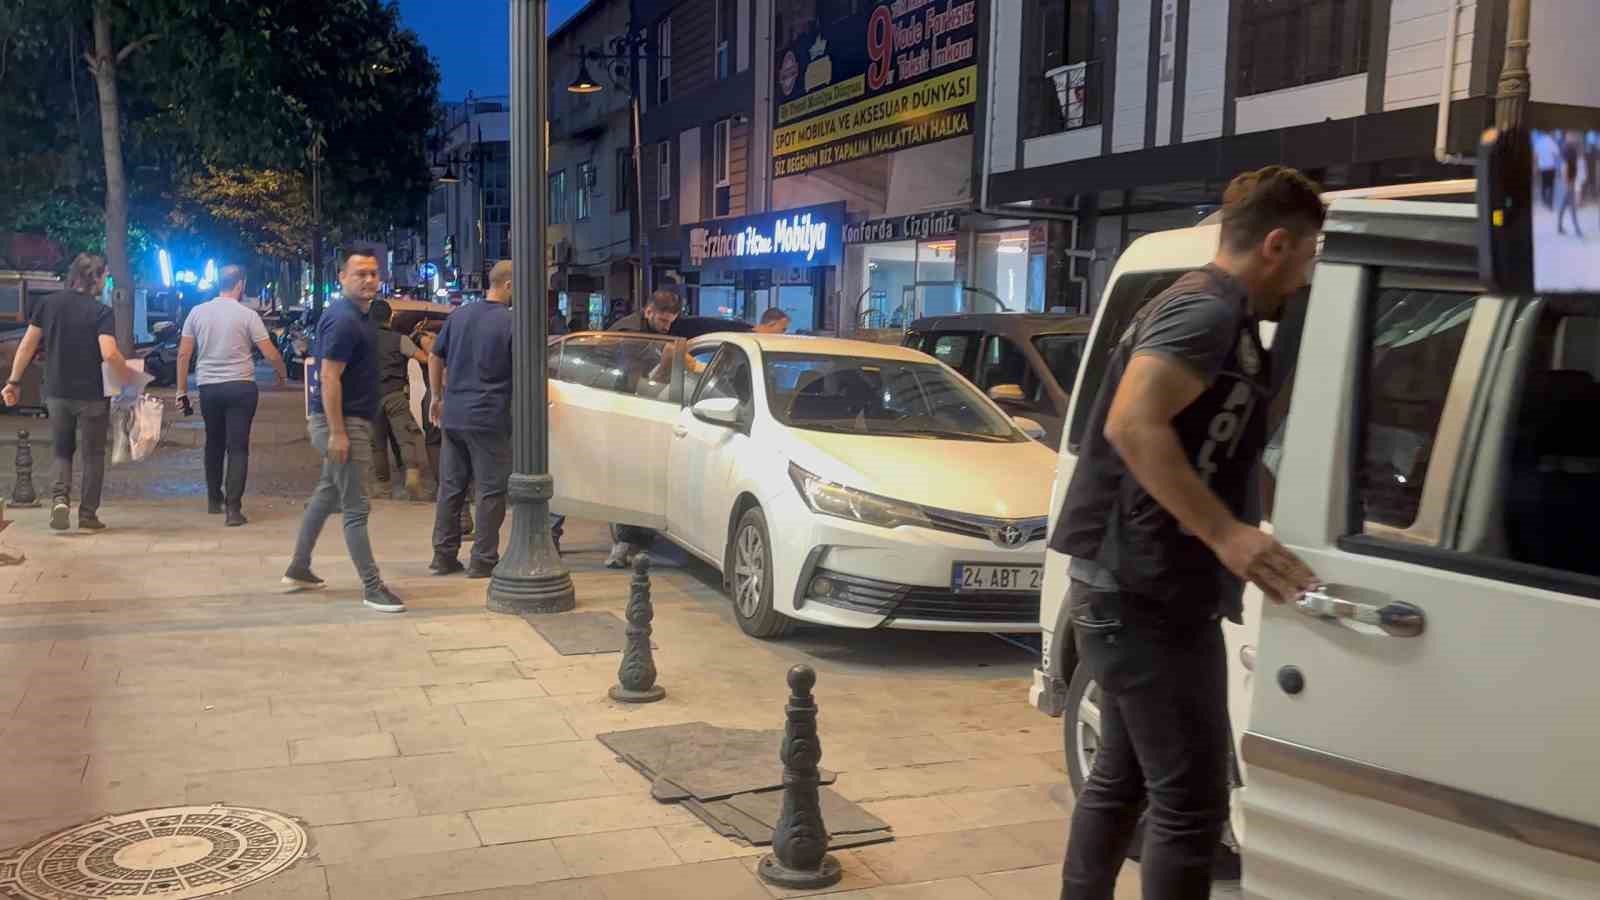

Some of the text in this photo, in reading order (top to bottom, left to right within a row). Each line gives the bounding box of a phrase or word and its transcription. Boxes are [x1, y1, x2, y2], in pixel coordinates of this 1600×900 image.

[867, 5, 893, 89] 9
[775, 130, 797, 150] SPOT
[839, 113, 851, 130] VE
[853, 100, 908, 126] AKSESUAR
[912, 77, 970, 108] DÜNYASI
[774, 213, 827, 261] Mobilya
[842, 220, 893, 242] Konforda
[964, 567, 1043, 588] 24 ABT 2
